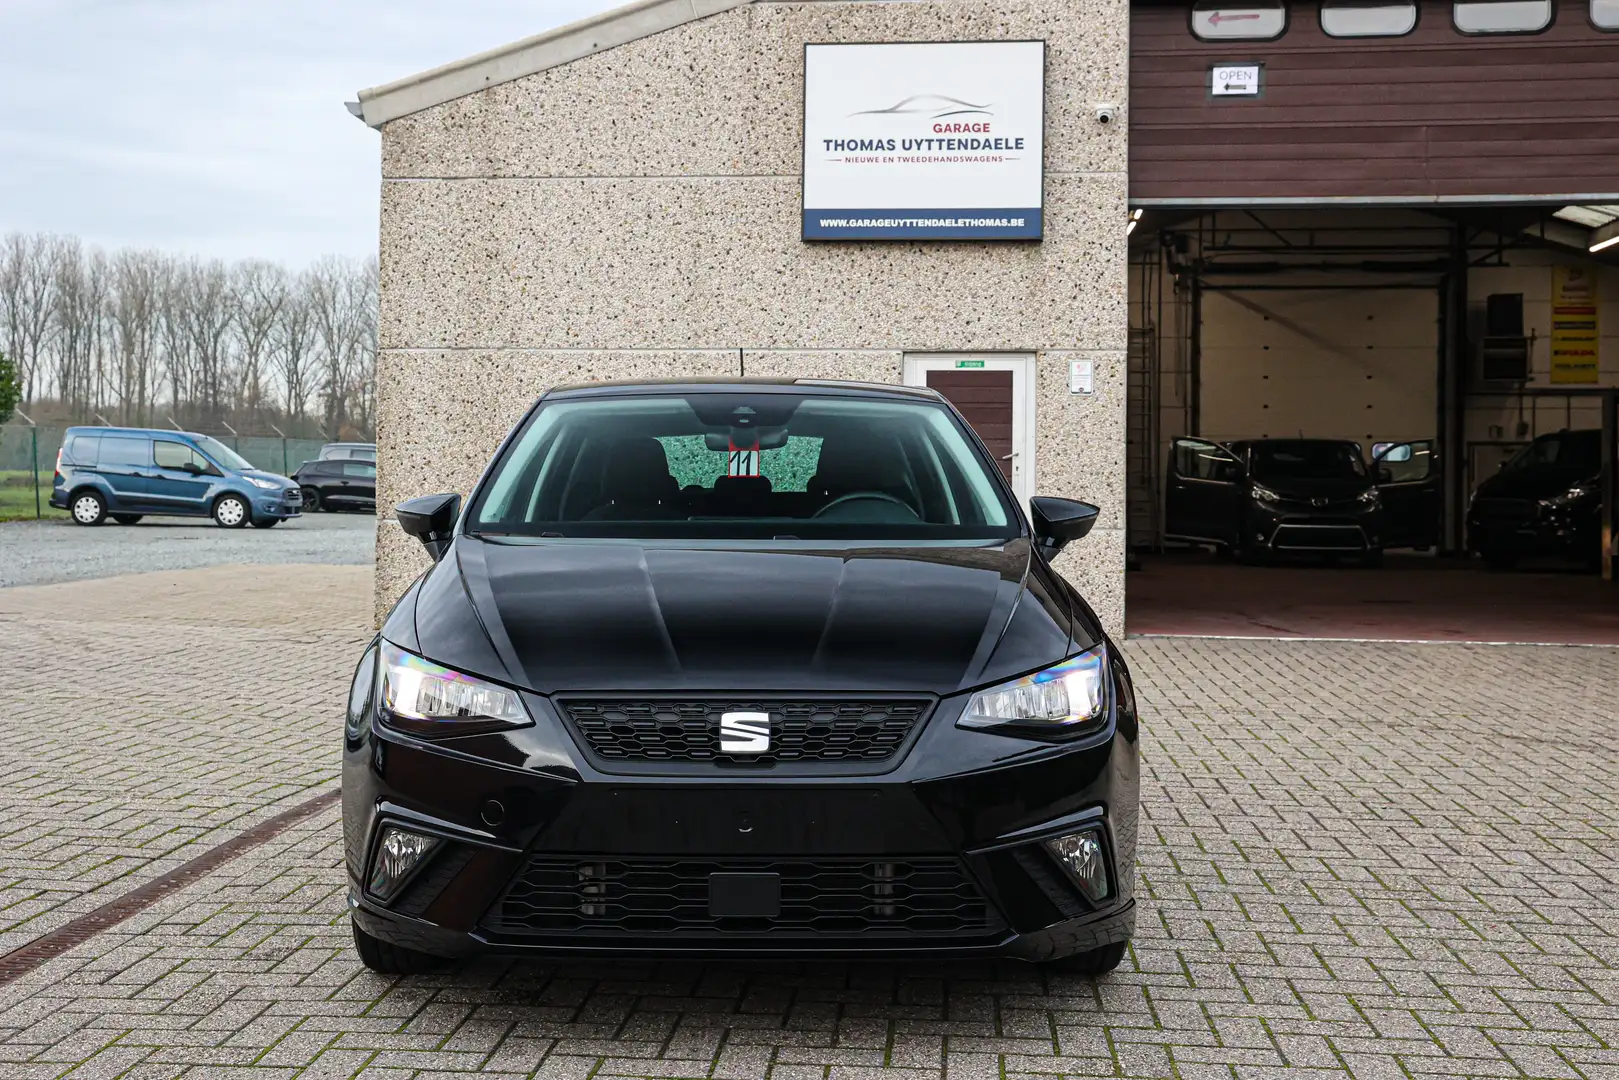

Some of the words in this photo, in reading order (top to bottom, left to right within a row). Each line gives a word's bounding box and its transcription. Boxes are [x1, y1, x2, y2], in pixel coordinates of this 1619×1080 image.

[1219, 70, 1252, 81] OPEN
[933, 122, 991, 134] GARAGE
[823, 138, 896, 152] THOMAS
[901, 137, 1025, 151] UYTTENDAELE
[844, 156, 880, 164] NIEUWE
[897, 155, 1003, 163] TWEEDEHANDSWAGENS
[819, 218, 1025, 228] WWW.GARAGEUYTTENDAELETHOMAS.BE
[730, 450, 752, 476] 11
